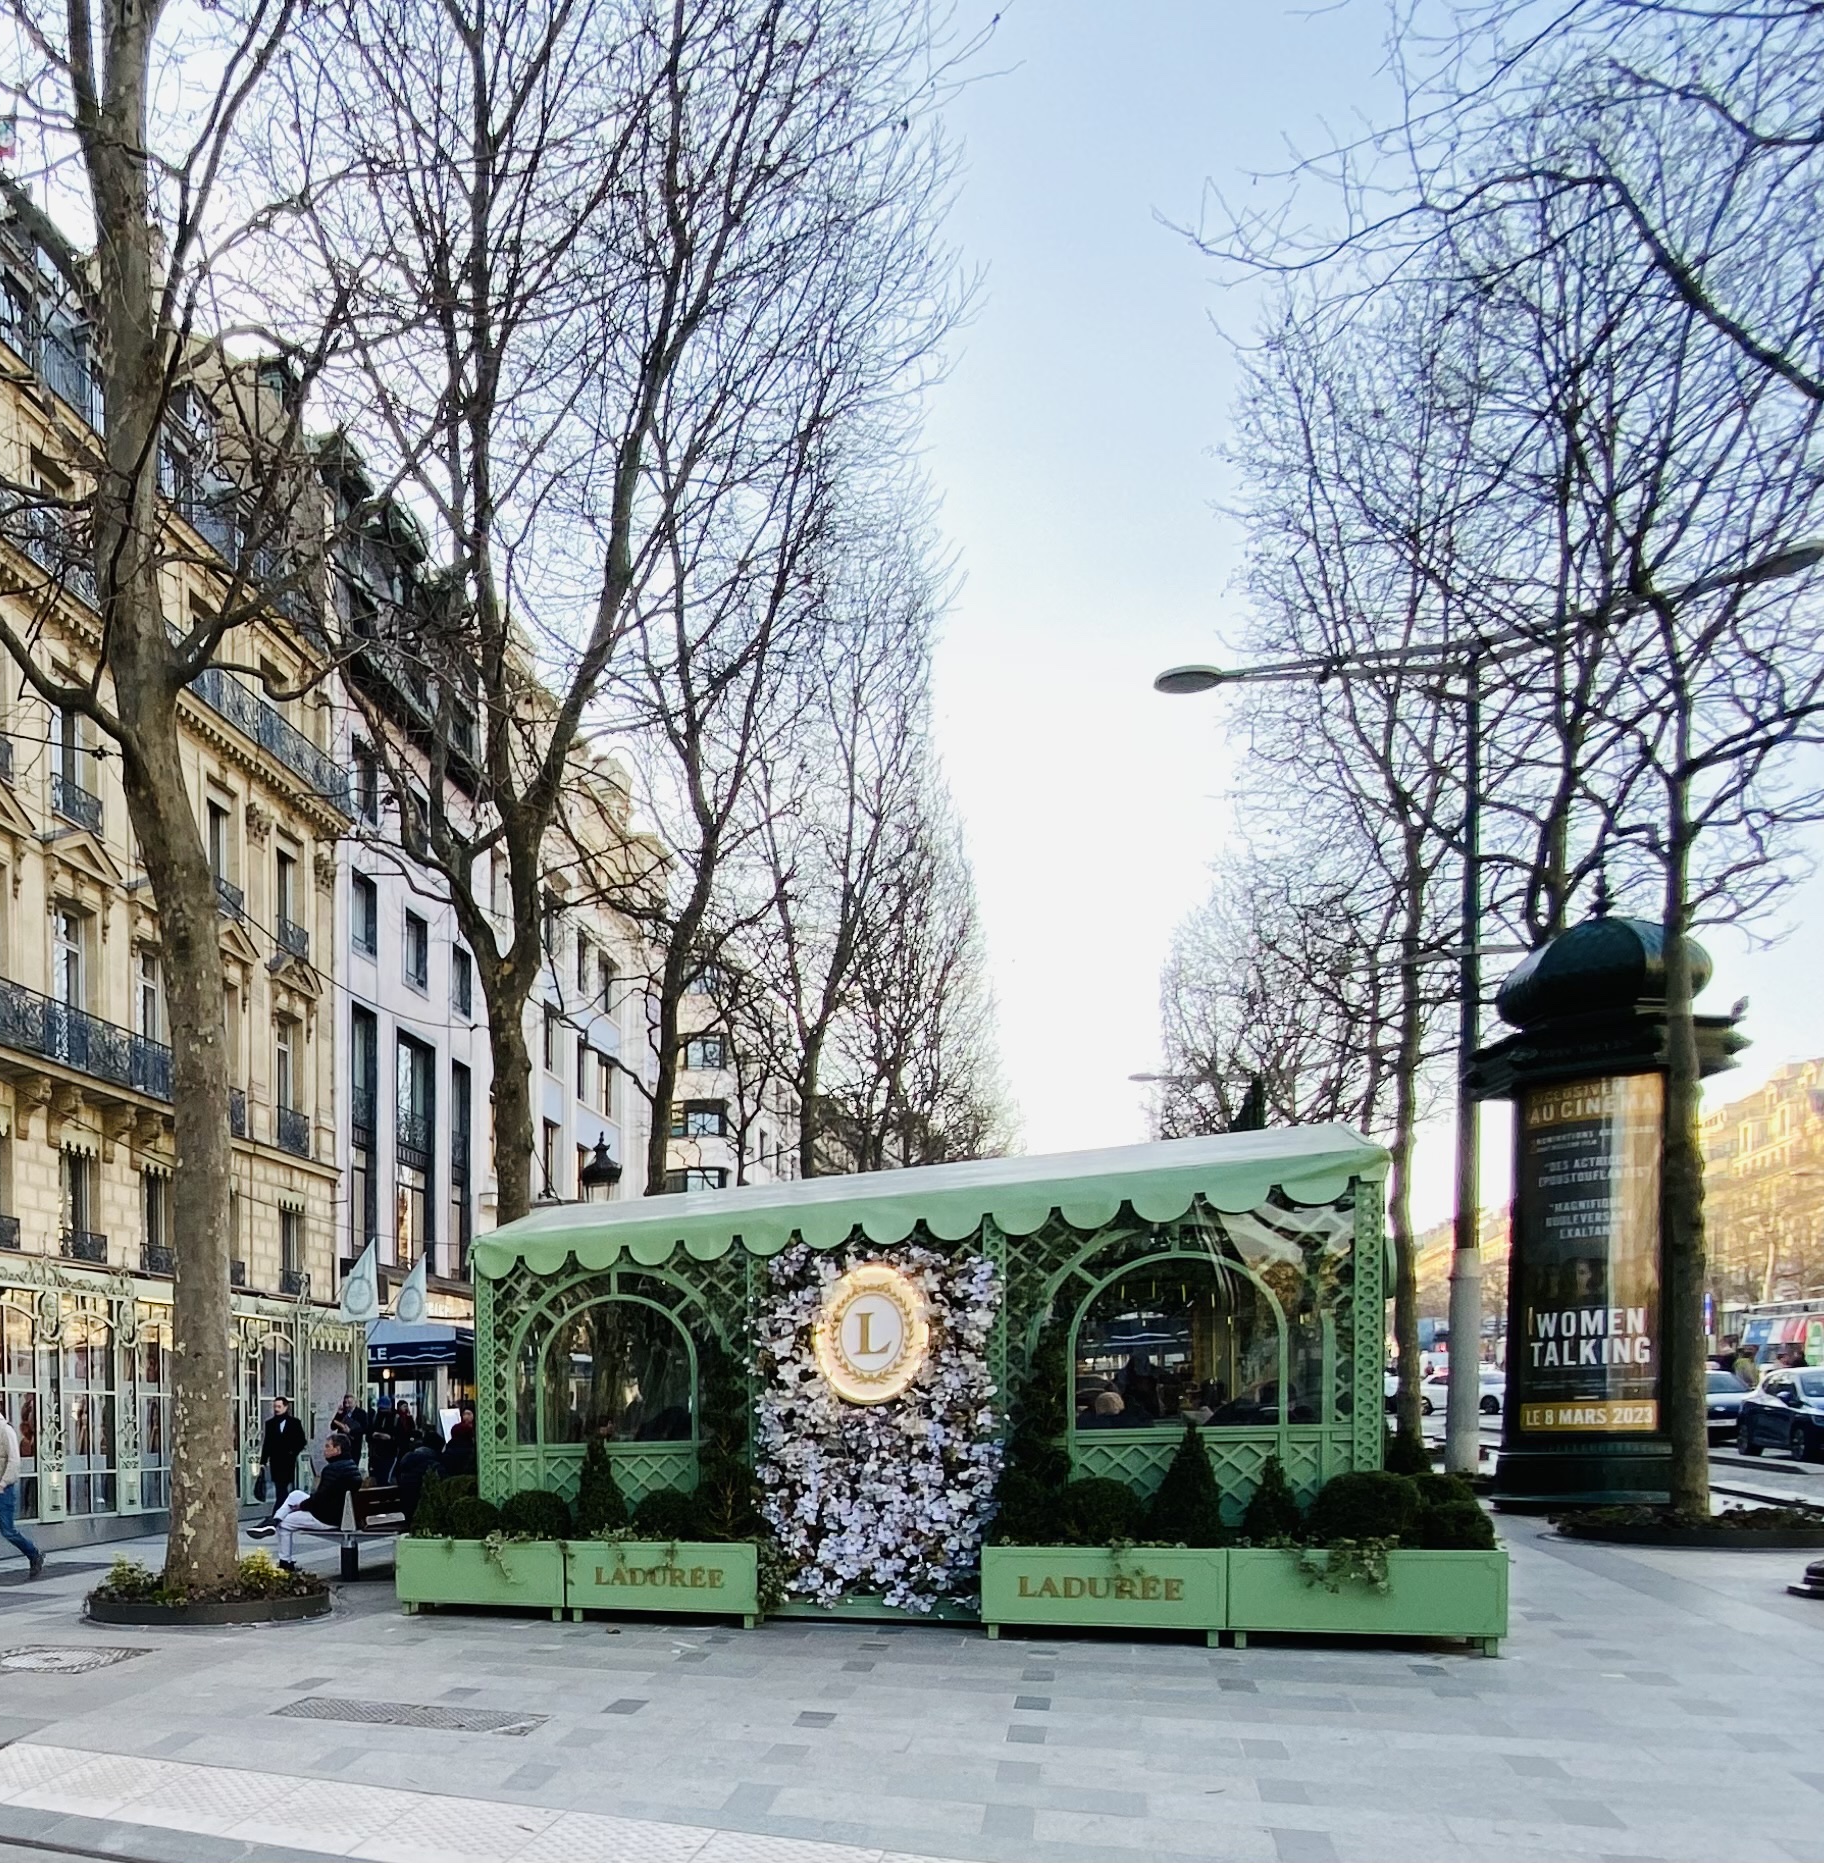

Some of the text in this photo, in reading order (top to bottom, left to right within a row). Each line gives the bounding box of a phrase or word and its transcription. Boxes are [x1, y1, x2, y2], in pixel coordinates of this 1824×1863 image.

[1530, 1103, 1555, 1124] AU
[853, 1311, 892, 1356] L
[1536, 1307, 1645, 1338] WOMEN
[1530, 1336, 1651, 1367] TALKING
[1526, 1406, 1653, 1426] LE 8 MARS 2023
